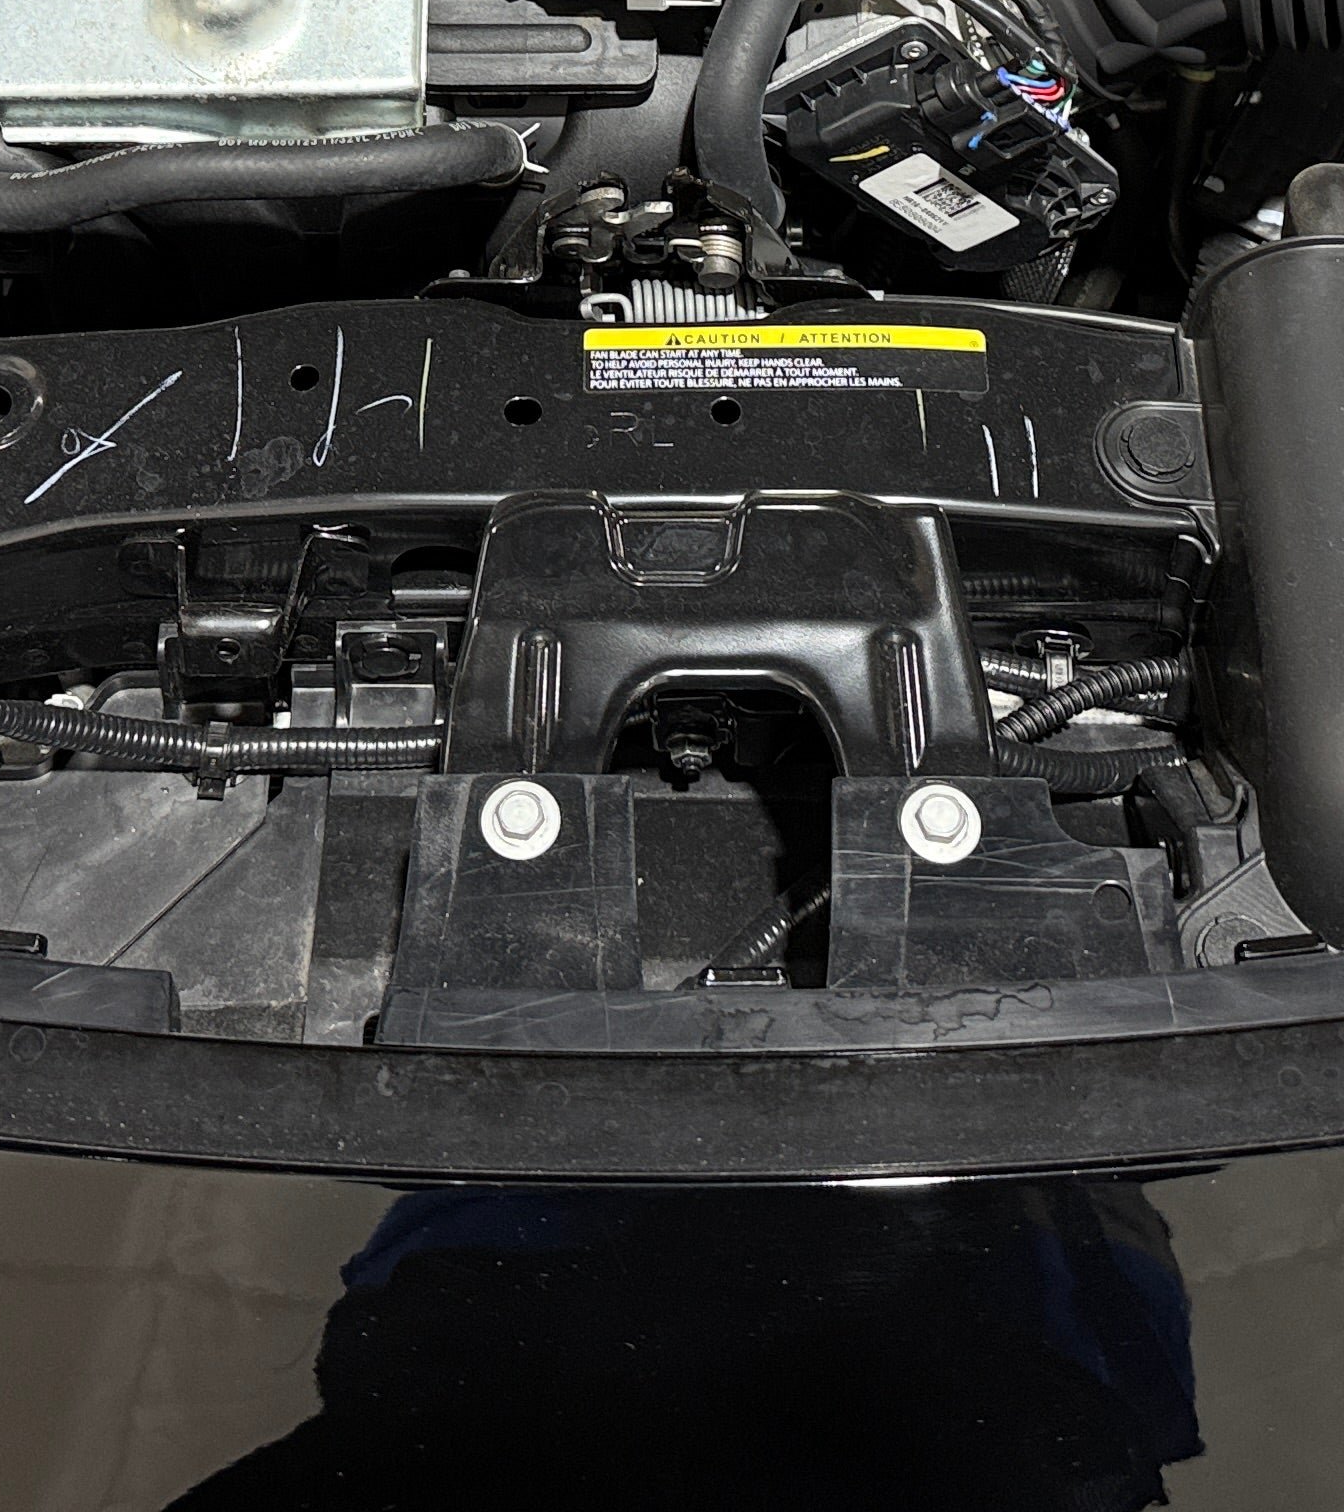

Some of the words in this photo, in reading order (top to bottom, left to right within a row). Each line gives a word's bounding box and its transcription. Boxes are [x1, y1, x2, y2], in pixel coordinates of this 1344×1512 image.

[684, 333, 760, 345] CAUTION
[798, 332, 892, 344] ATTENTION
[590, 350, 608, 359] FAN
[609, 350, 638, 359] BLADE
[639, 350, 659, 359] CAN
[660, 349, 687, 359] START
[688, 349, 698, 358] AT
[700, 349, 719, 358] ANY
[591, 359, 604, 368] TO
[605, 359, 627, 368] HELP
[629, 359, 656, 368] AVOID
[657, 359, 704, 368] PERSONAL
[738, 358, 760, 367] KEEP
[761, 358, 793, 367] HANDS
[590, 369, 603, 378] LE
[603, 369, 666, 378] VENTILATEUR
[667, 368, 704, 378] RISQUE
[705, 368, 719, 378] DE
[784, 367, 811, 377] TOUT
[590, 379, 618, 388] POUR
[653, 378, 686, 388] TOUTE
[738, 378, 752, 388] NE
[753, 378, 772, 387] PAS
[773, 378, 787, 387] EN
[788, 377, 848, 387] APPROCHER
[849, 377, 866, 387] LES
[867, 377, 904, 387] MAINS.
